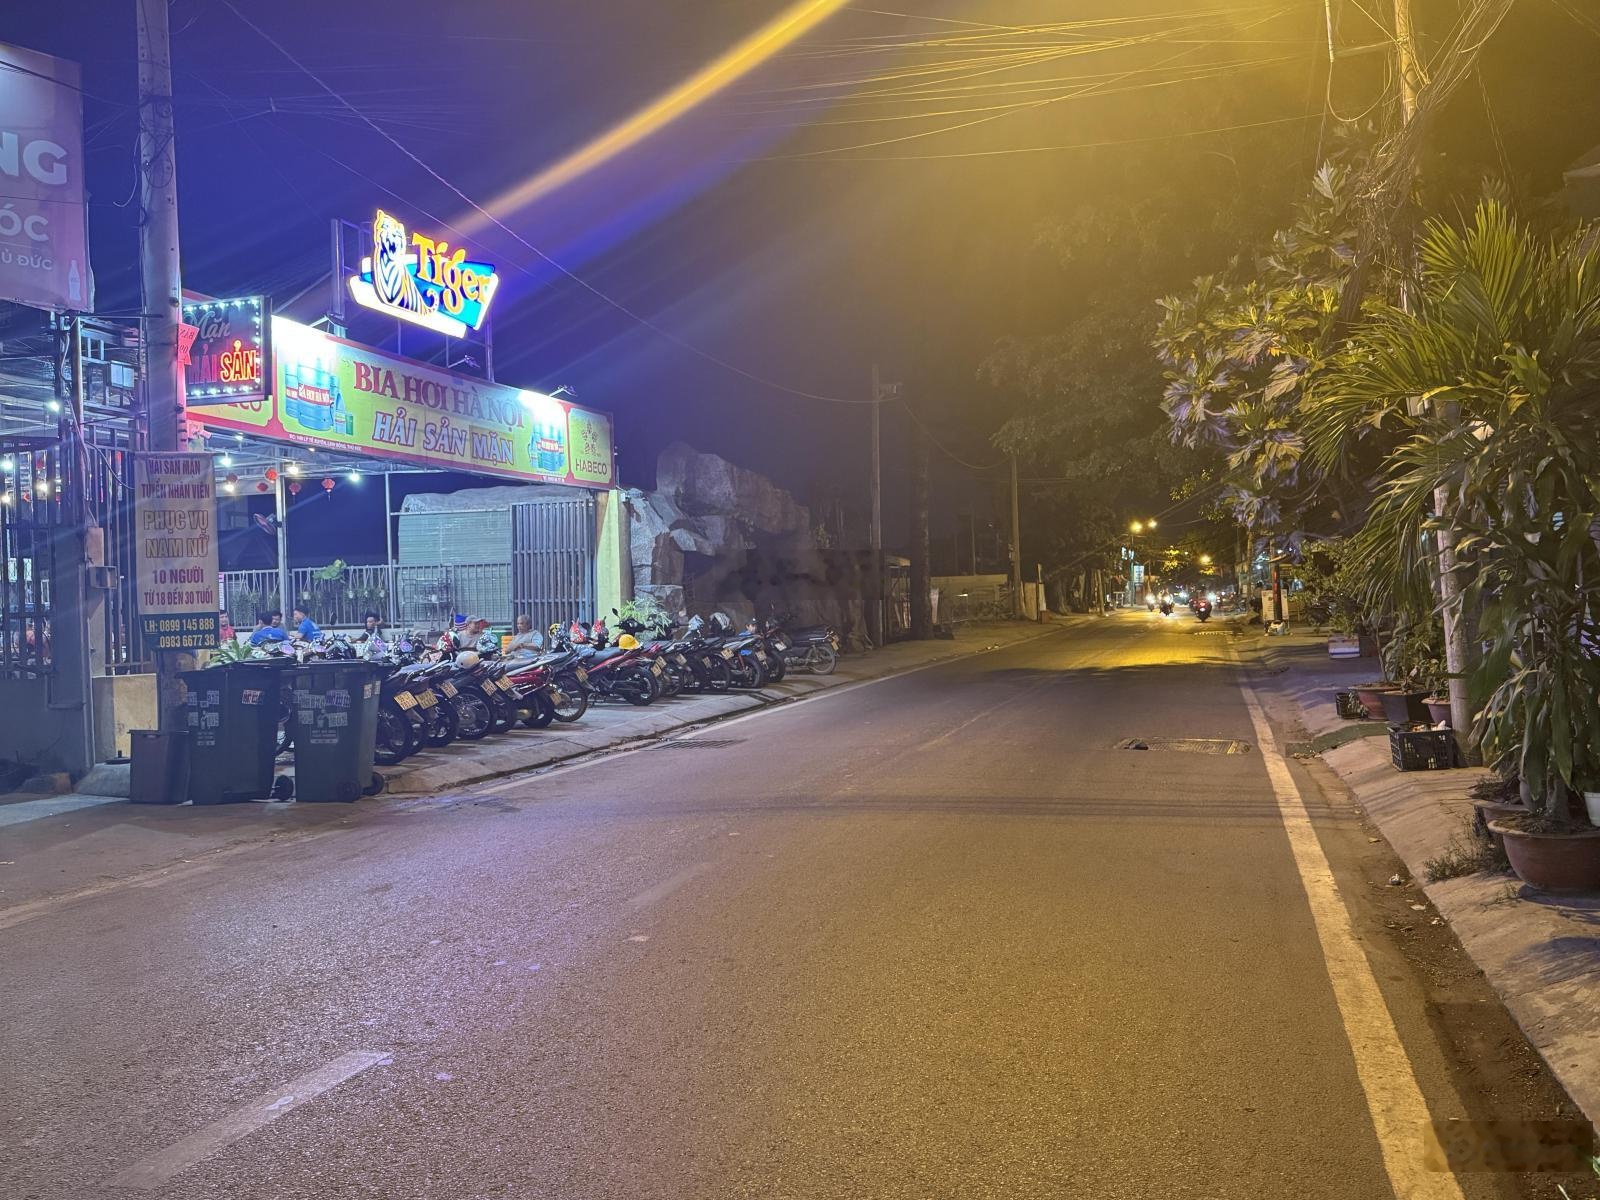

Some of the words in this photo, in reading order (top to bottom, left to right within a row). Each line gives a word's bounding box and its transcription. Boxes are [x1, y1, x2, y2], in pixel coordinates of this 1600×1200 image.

[411, 232, 491, 314] Tiger
[220, 339, 257, 382] SẢN
[353, 361, 400, 400] BIA
[402, 375, 449, 410] HƠI
[451, 385, 486, 421] HÀ
[486, 396, 525, 433] NỘI
[372, 406, 418, 448] HẢI
[423, 416, 467, 458] SẢN
[471, 430, 514, 466] MẶN
[575, 458, 608, 476] HABECO
[168, 480, 190, 498] NHÂN
[191, 481, 210, 499] VIÊN
[144, 510, 186, 534] PHỤC
[188, 510, 208, 533] VỤ
[146, 538, 183, 558] NAM
[186, 533, 209, 558] NỮ
[152, 569, 166, 584] 10
[170, 566, 204, 584] NGƯỜI
[144, 588, 155, 606] TỪ
[156, 592, 166, 605] 18
[167, 587, 184, 605] ĐẾN
[185, 591, 194, 604] 30
[144, 620, 158, 633] LH:
[160, 619, 180, 632] 0899
[183, 618, 197, 631] 145
[199, 618, 214, 630] 888
[160, 635, 180, 648] 0983
[182, 635, 202, 646] 6677
[204, 634, 214, 646] 38
